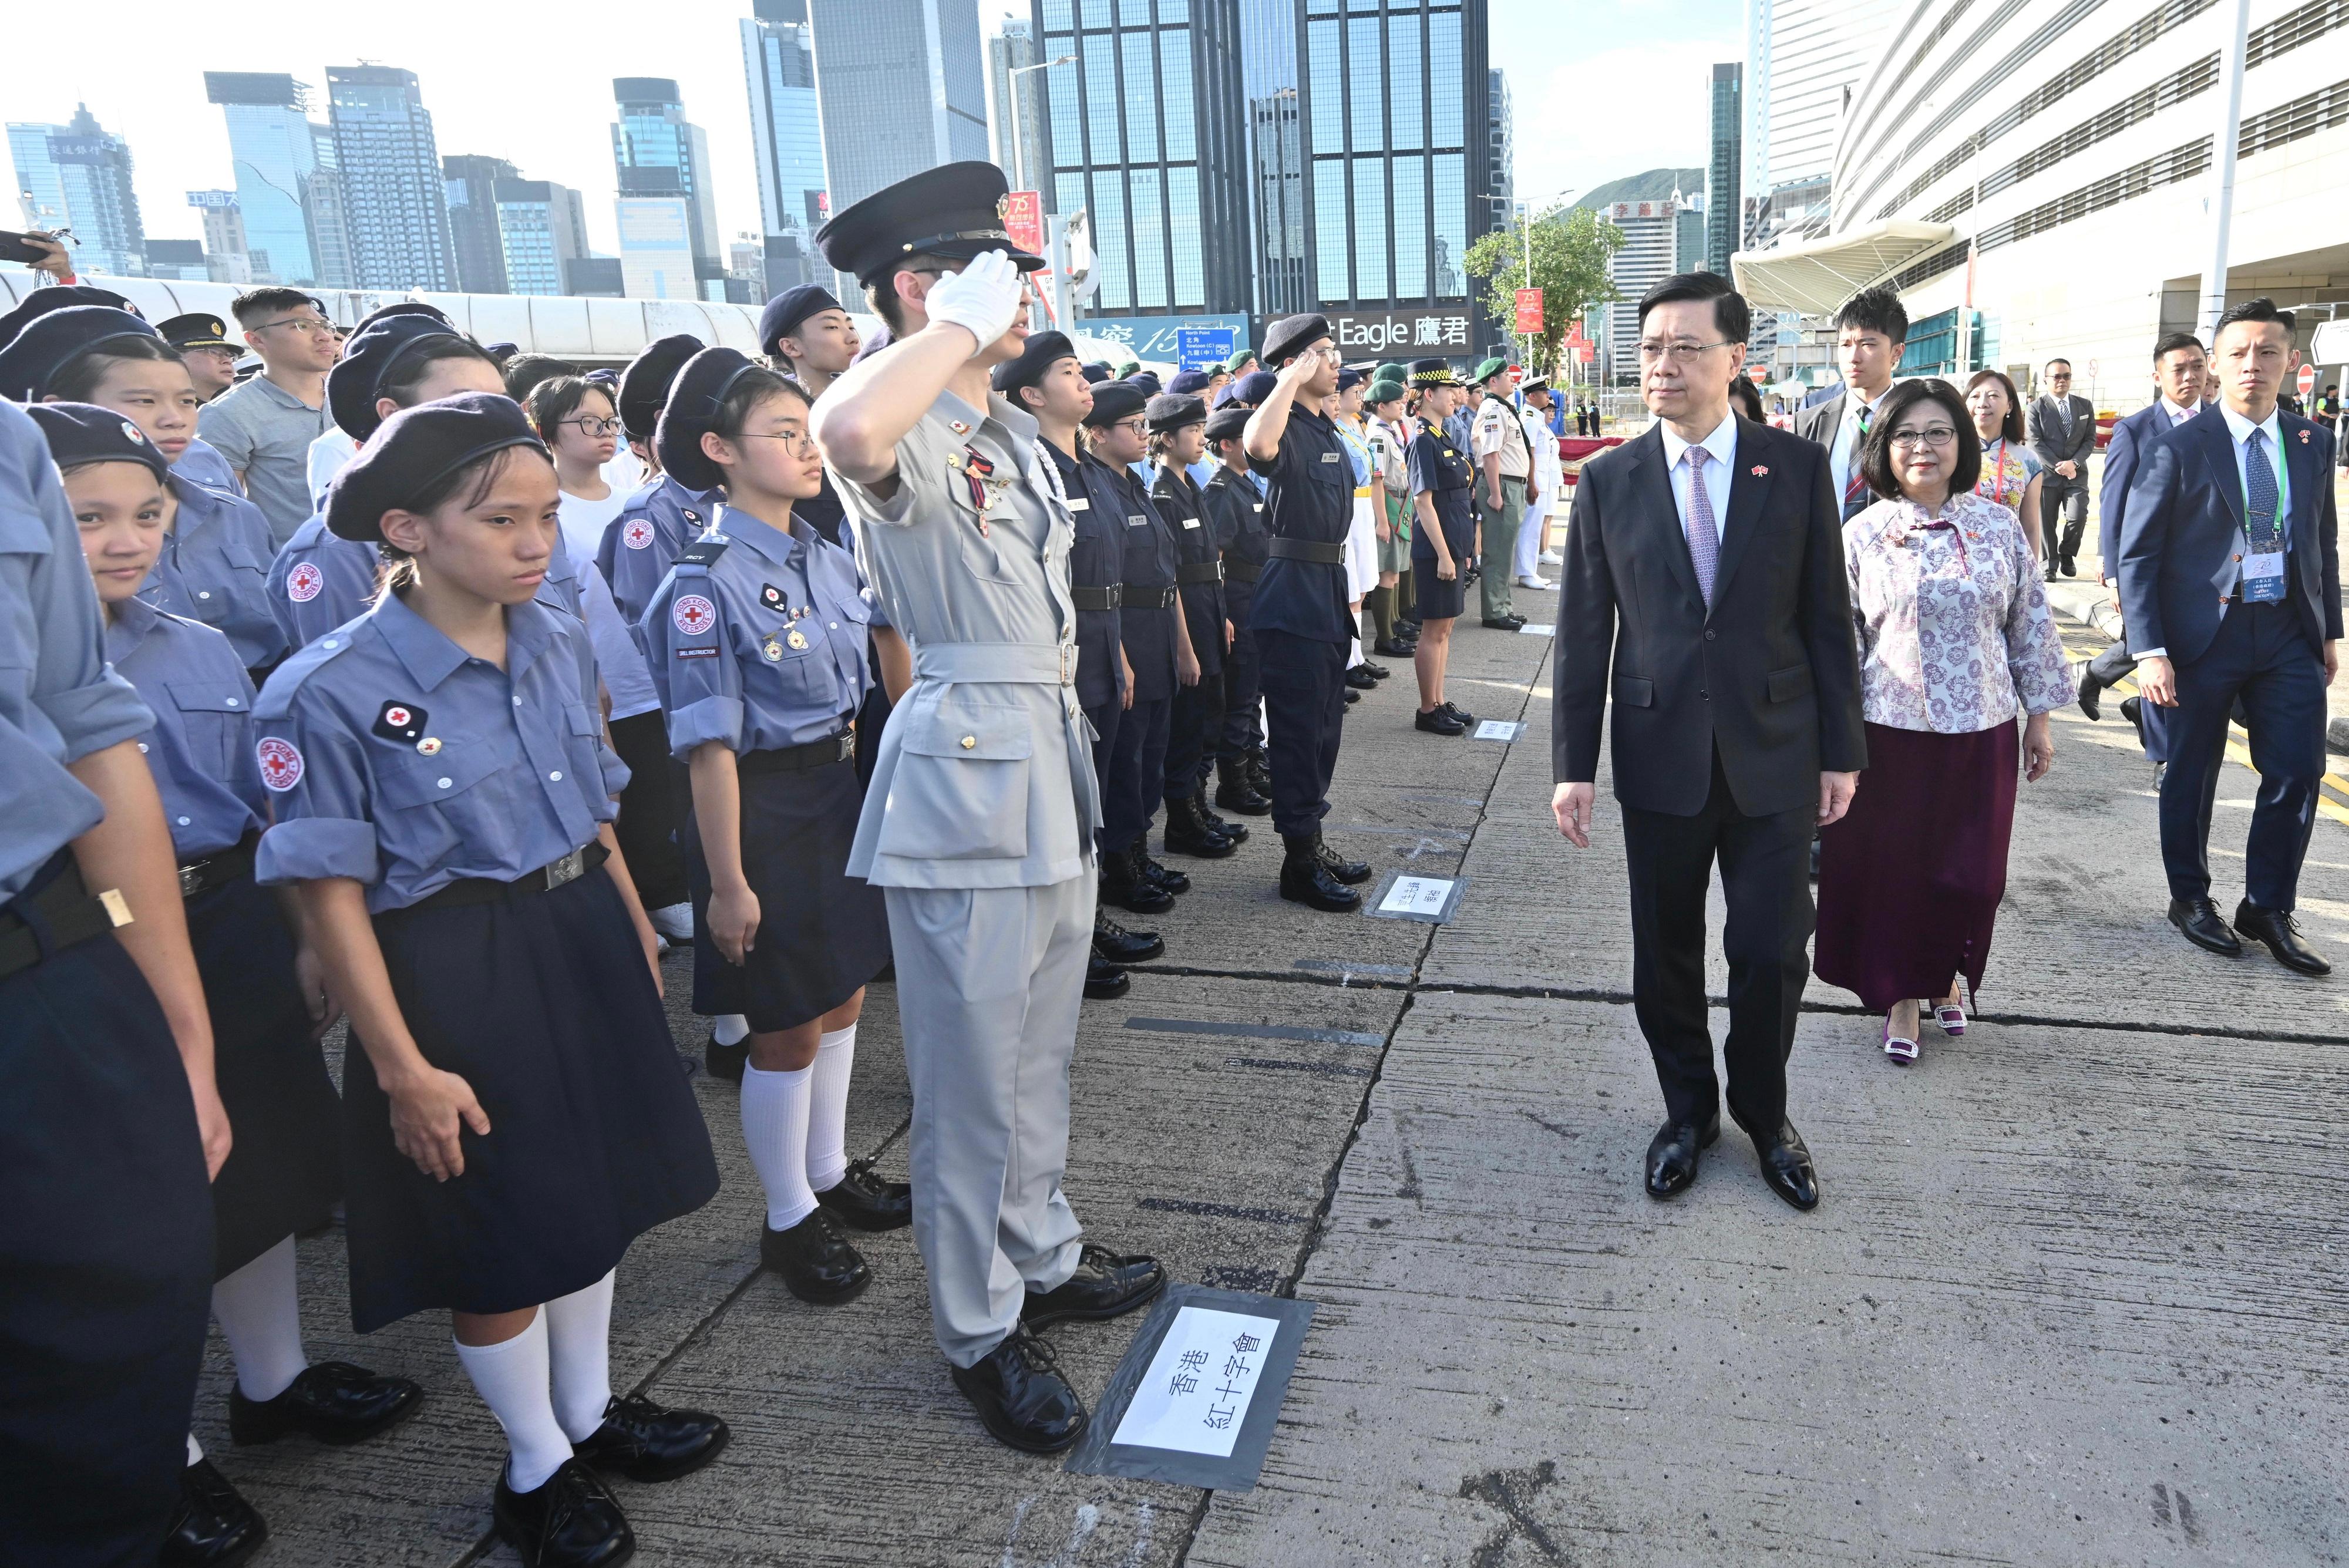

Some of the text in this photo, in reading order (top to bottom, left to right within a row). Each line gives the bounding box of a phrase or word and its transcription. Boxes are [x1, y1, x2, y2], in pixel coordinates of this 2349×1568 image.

[1011, 195, 1029, 214] 75
[1615, 202, 1674, 217] 李錦記
[1522, 291, 1534, 303] 75
[1339, 315, 1408, 352] Eagle
[1414, 316, 1469, 346] 鷹君
[626, 522, 650, 534] HONG KONG
[636, 534, 651, 546] CROSS
[677, 599, 710, 614] HONG KONG
[678, 617, 710, 631] RED CROSS
[1169, 1350, 1209, 1396] 香港
[1203, 1331, 1261, 1430] 紅十字會
